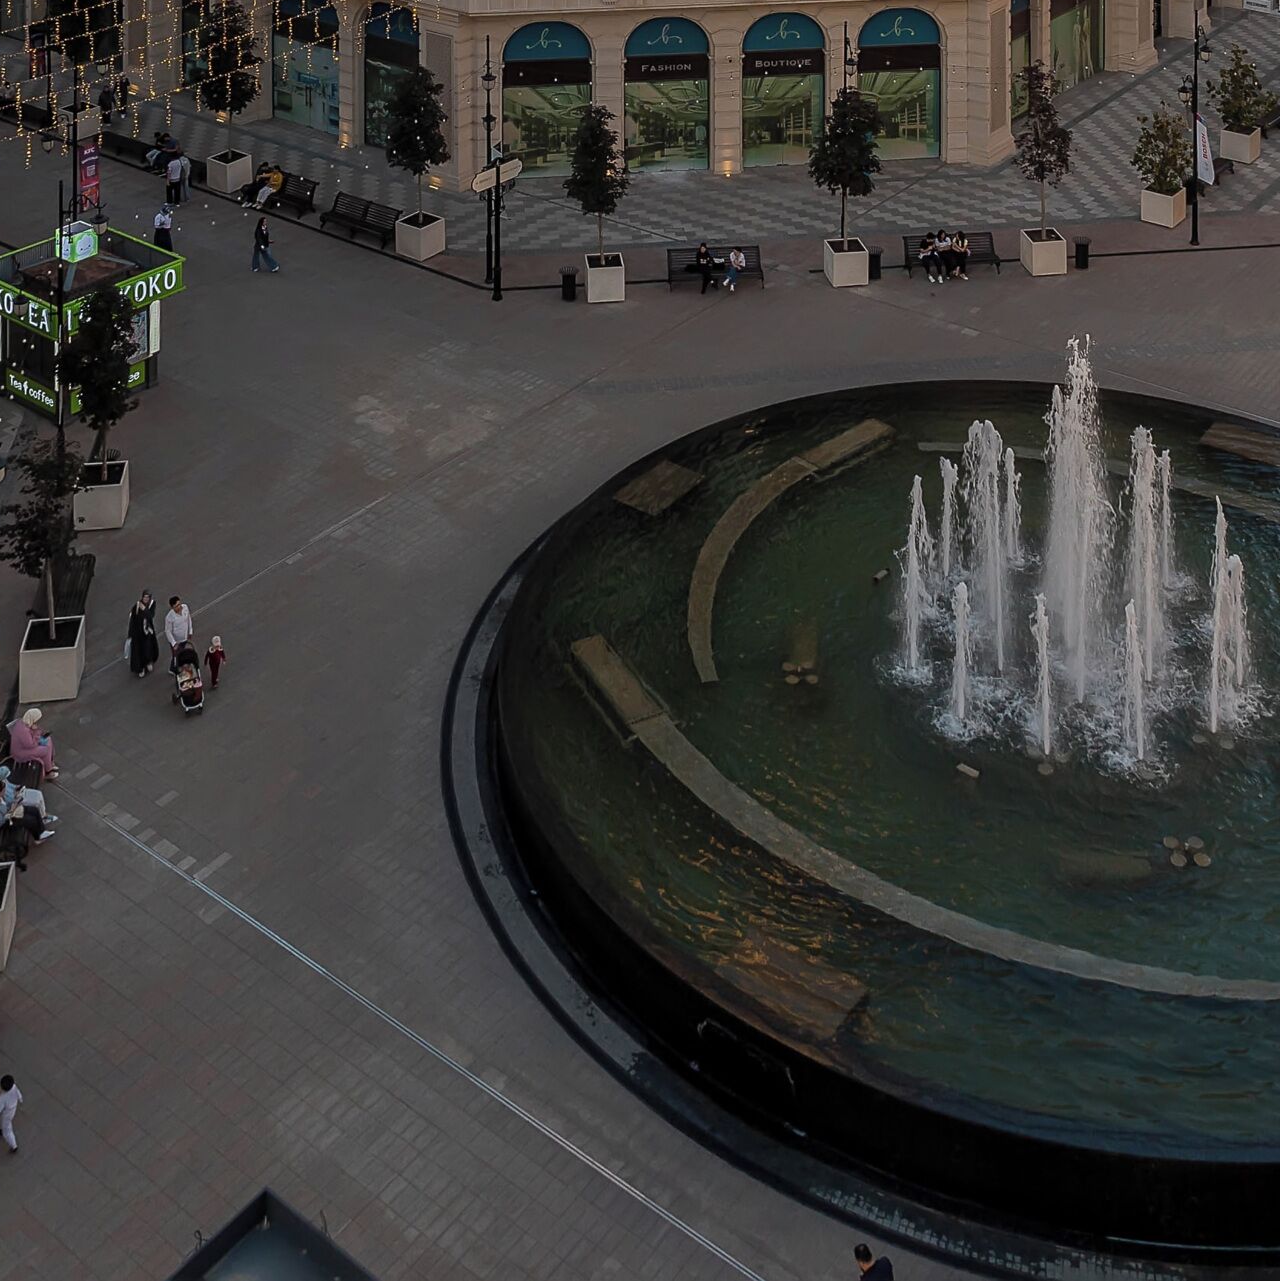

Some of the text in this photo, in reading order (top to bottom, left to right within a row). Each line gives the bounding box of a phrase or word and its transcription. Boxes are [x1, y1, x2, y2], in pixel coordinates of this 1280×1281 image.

[641, 63, 692, 73] FASHION
[755, 58, 812, 68] BOUTIQUE
[9, 374, 55, 408] Tea coffee
